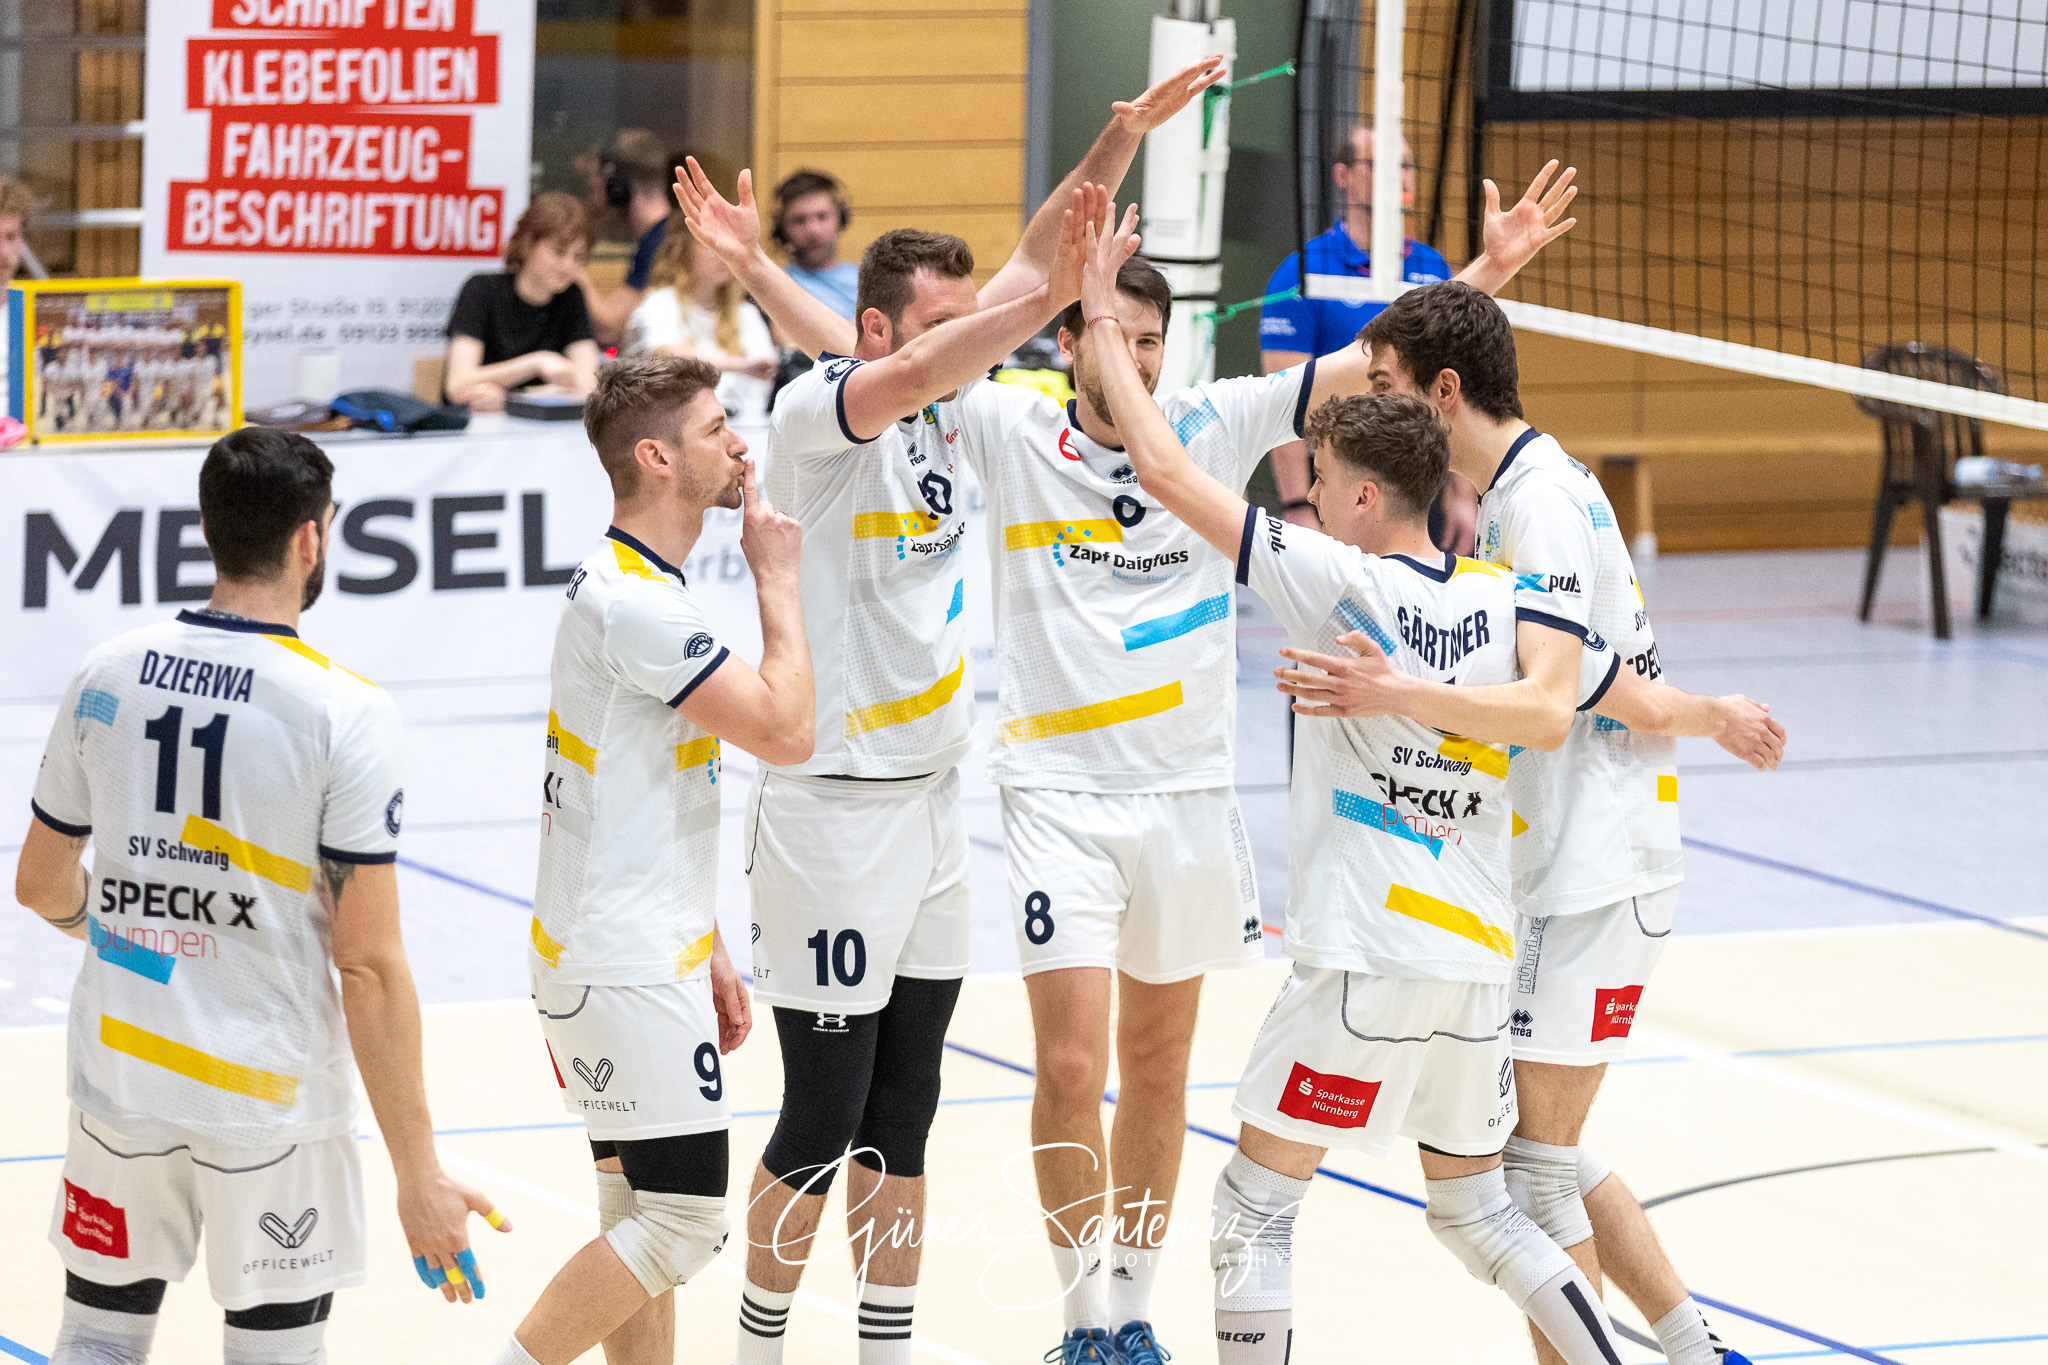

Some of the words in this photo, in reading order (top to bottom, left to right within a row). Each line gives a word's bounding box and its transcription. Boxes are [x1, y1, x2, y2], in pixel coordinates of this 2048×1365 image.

[204, 47, 479, 106] KLEBEFOLIEN
[222, 122, 465, 183] FAHRZEUG-
[183, 188, 498, 250] BESCHRIFTUNG
[23, 490, 584, 611] MESEL
[1069, 544, 1111, 565] Zapf
[1113, 549, 1189, 573] Daigfuss
[138, 648, 255, 703] DZIERWA
[145, 704, 231, 821] 11
[1391, 746, 1414, 767] SV
[1415, 750, 1474, 776] Schwaig
[128, 835, 151, 857] SV
[156, 838, 230, 872] Schwaig
[100, 877, 217, 925] SPECK
[1025, 890, 1055, 945] 8
[807, 928, 867, 987] 10
[694, 1042, 723, 1102] 9
[1316, 1088, 1366, 1107] Sparkasse
[1311, 1100, 1359, 1119] Nürnberg
[243, 1249, 335, 1275] OFFICEWELT
[1232, 1331, 1266, 1345] cep
